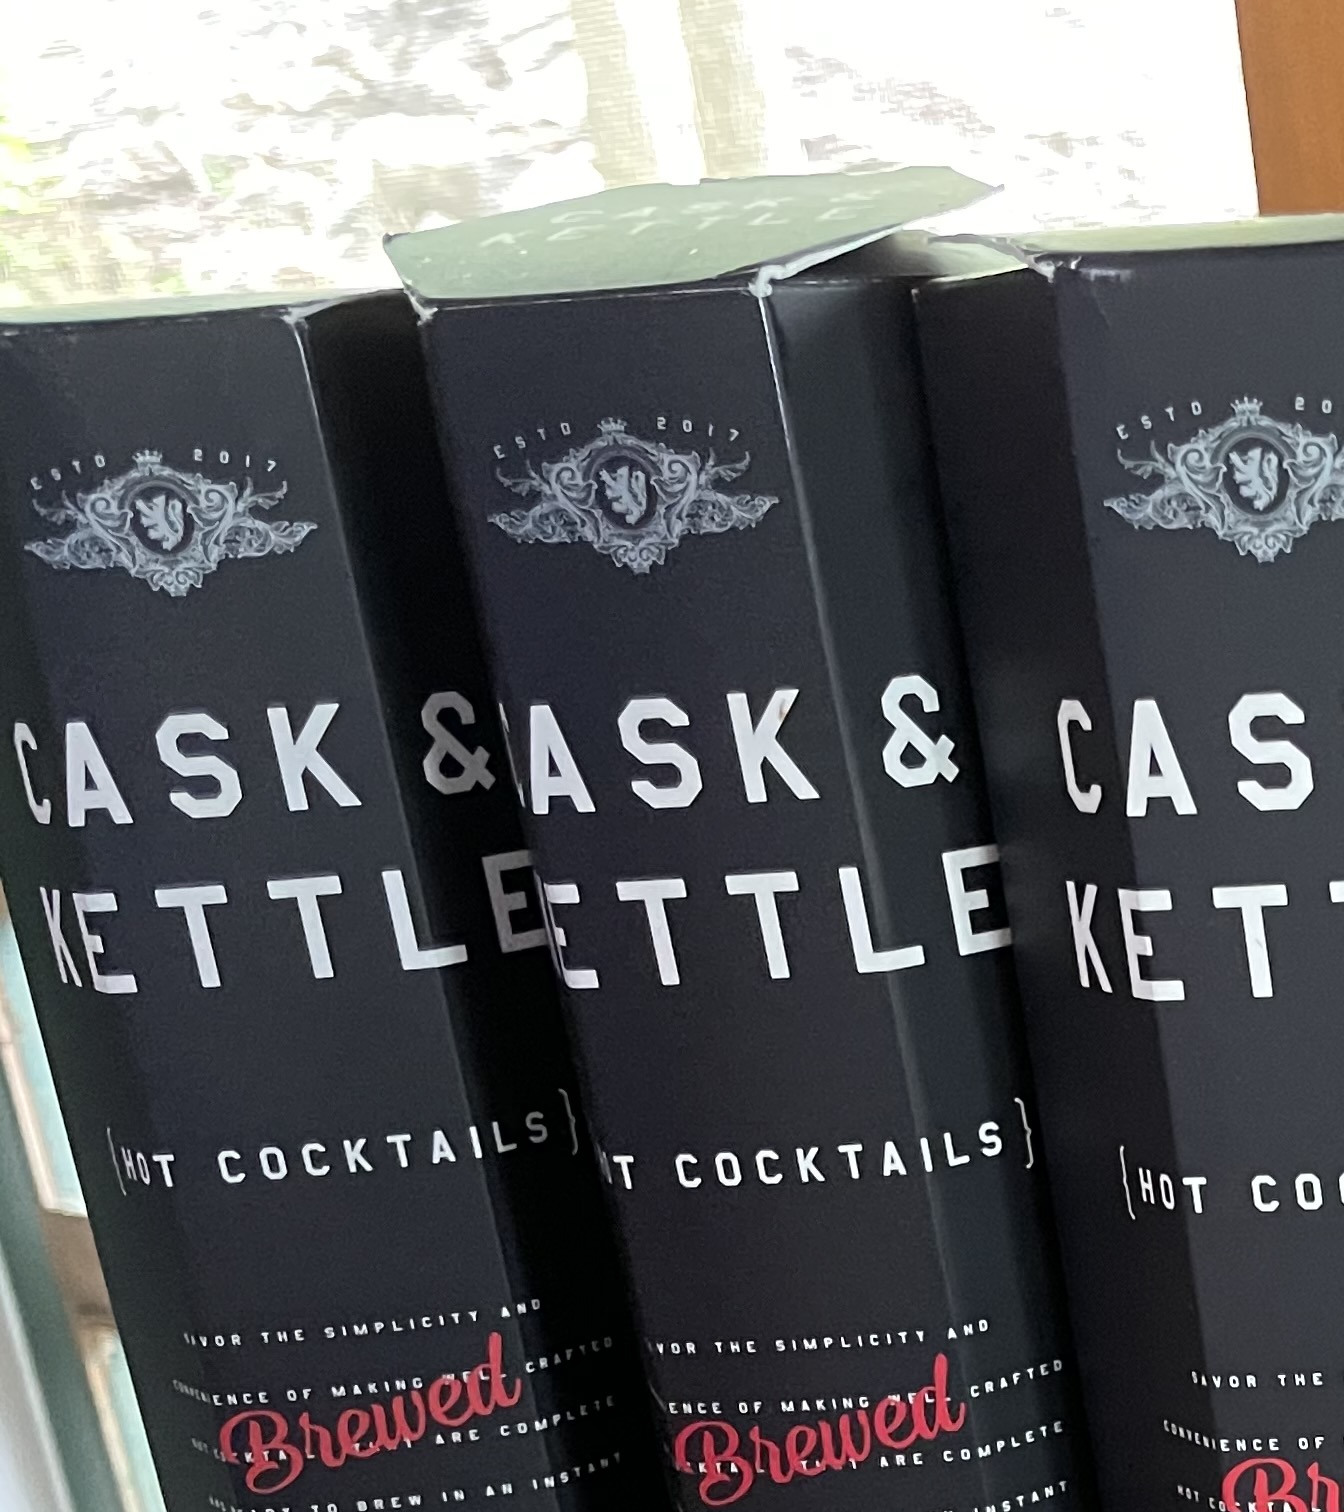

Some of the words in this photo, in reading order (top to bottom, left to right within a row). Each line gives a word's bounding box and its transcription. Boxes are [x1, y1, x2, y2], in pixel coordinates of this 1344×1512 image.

[655, 415, 741, 442] 2017
[194, 448, 278, 473] 2017
[880, 674, 960, 788] &
[14, 703, 362, 828] CASK
[420, 690, 497, 796] &
[39, 849, 546, 994] KETTLE
[535, 844, 1013, 989] ETTLE
[324, 1309, 479, 1340] SIMPLICITY
[500, 1298, 541, 1319] AND
[775, 1330, 925, 1352] SIMPLICITY
[947, 1319, 989, 1340] AND
[331, 1376, 423, 1397] MAKING
[780, 1396, 870, 1413] MAKING
[969, 1359, 1063, 1398] CRAFTED
[1191, 1370, 1258, 1389] SAVOR
[1277, 1372, 1324, 1387] THE
[218, 1331, 522, 1495] Brewed
[500, 1395, 614, 1437] COMPLETE
[674, 1352, 966, 1506] Brewed
[879, 1452, 924, 1469] ARE
[942, 1421, 1063, 1463] COMPLETE
[356, 1494, 422, 1512] BREW
[532, 1451, 621, 1490] INSTANT
